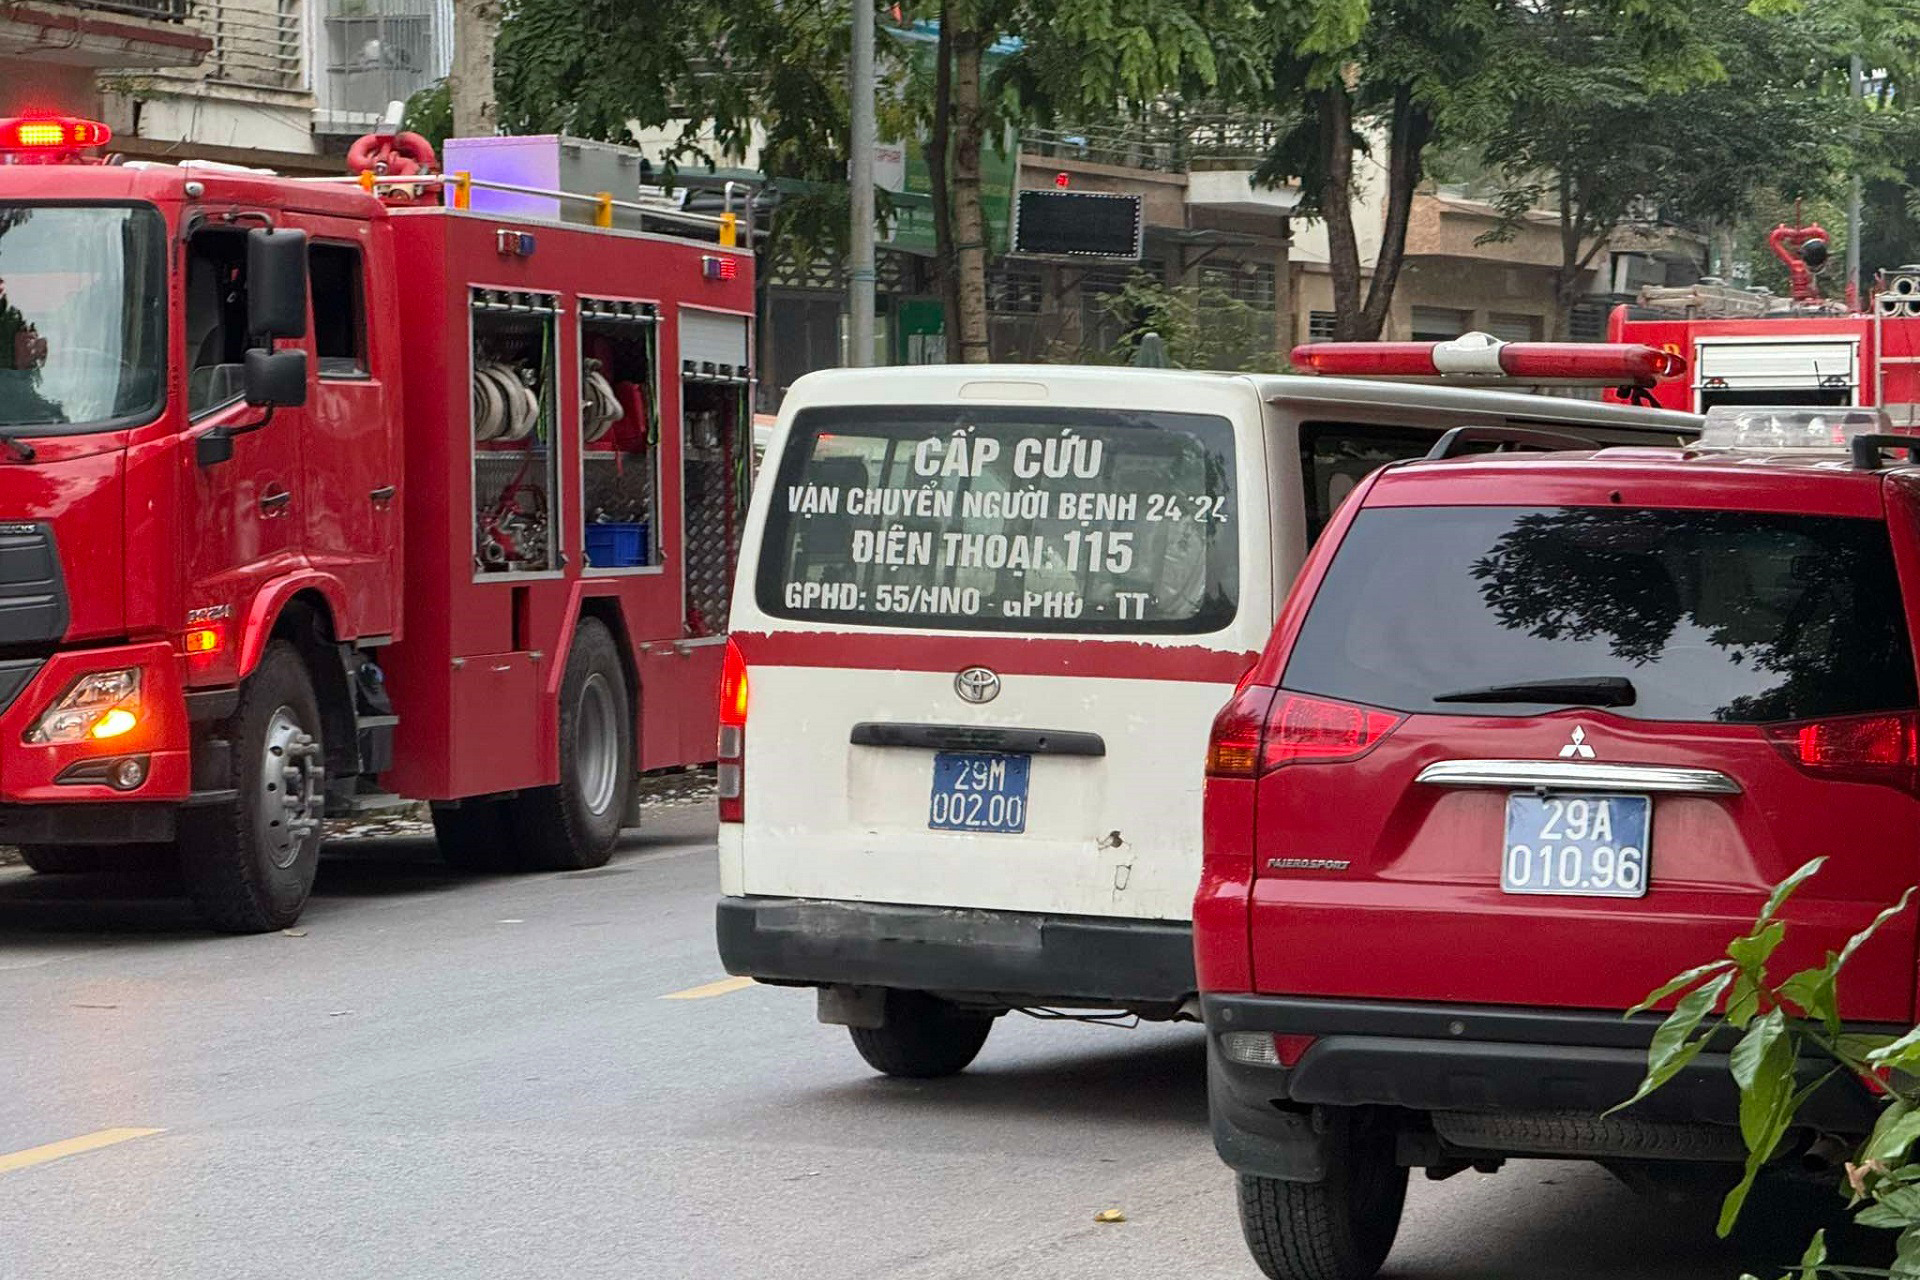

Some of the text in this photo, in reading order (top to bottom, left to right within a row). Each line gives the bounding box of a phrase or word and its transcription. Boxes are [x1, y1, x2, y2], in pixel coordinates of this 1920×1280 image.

[914, 425, 1103, 479] CẤP CỨU
[846, 480, 954, 517] CHUYỂN
[961, 484, 1050, 520] NGƯỜI
[852, 524, 932, 571] ĐIỆN
[1064, 531, 1134, 574] 115
[954, 759, 1006, 791] 29M
[933, 792, 1022, 827] 002.00
[1539, 799, 1613, 841] 29A
[1508, 845, 1642, 889] 010.96
